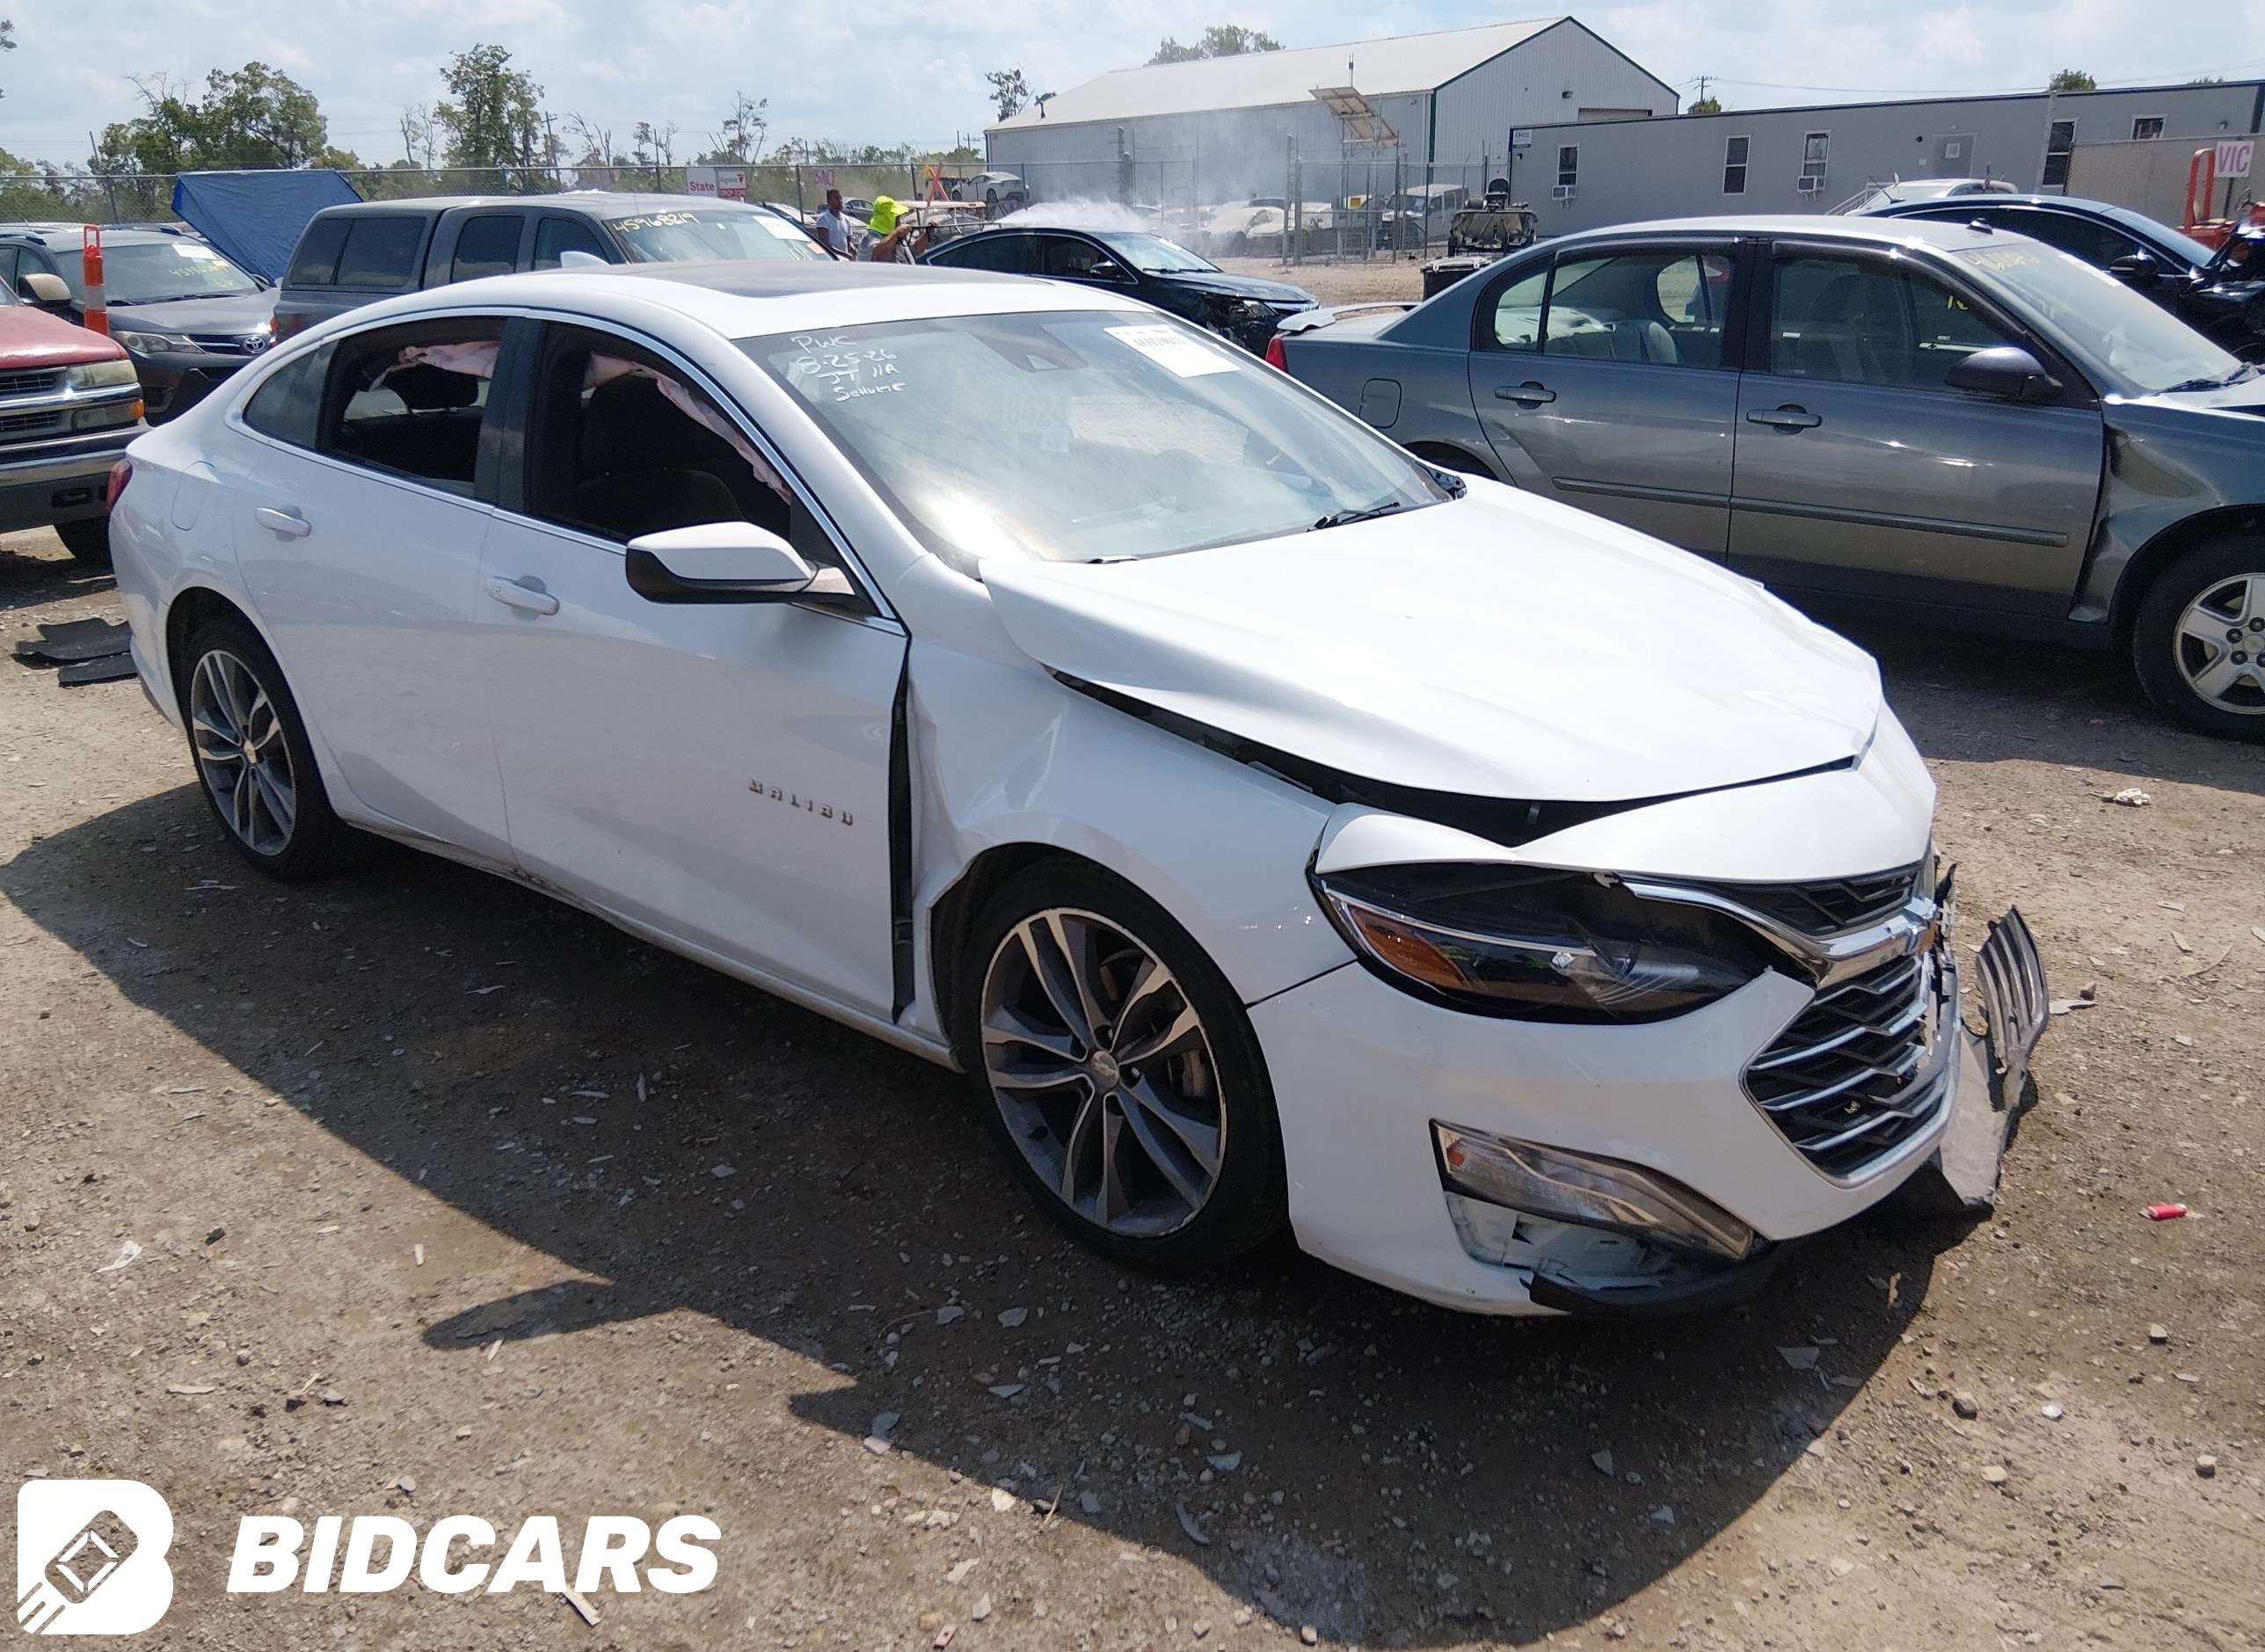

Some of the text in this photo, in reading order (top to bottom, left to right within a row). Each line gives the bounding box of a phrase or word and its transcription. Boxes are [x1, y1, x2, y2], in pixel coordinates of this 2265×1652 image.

[2218, 145, 2251, 172] VIC
[689, 181, 716, 192] State
[613, 212, 701, 233] 45968219
[747, 778, 854, 826] MALIBU
